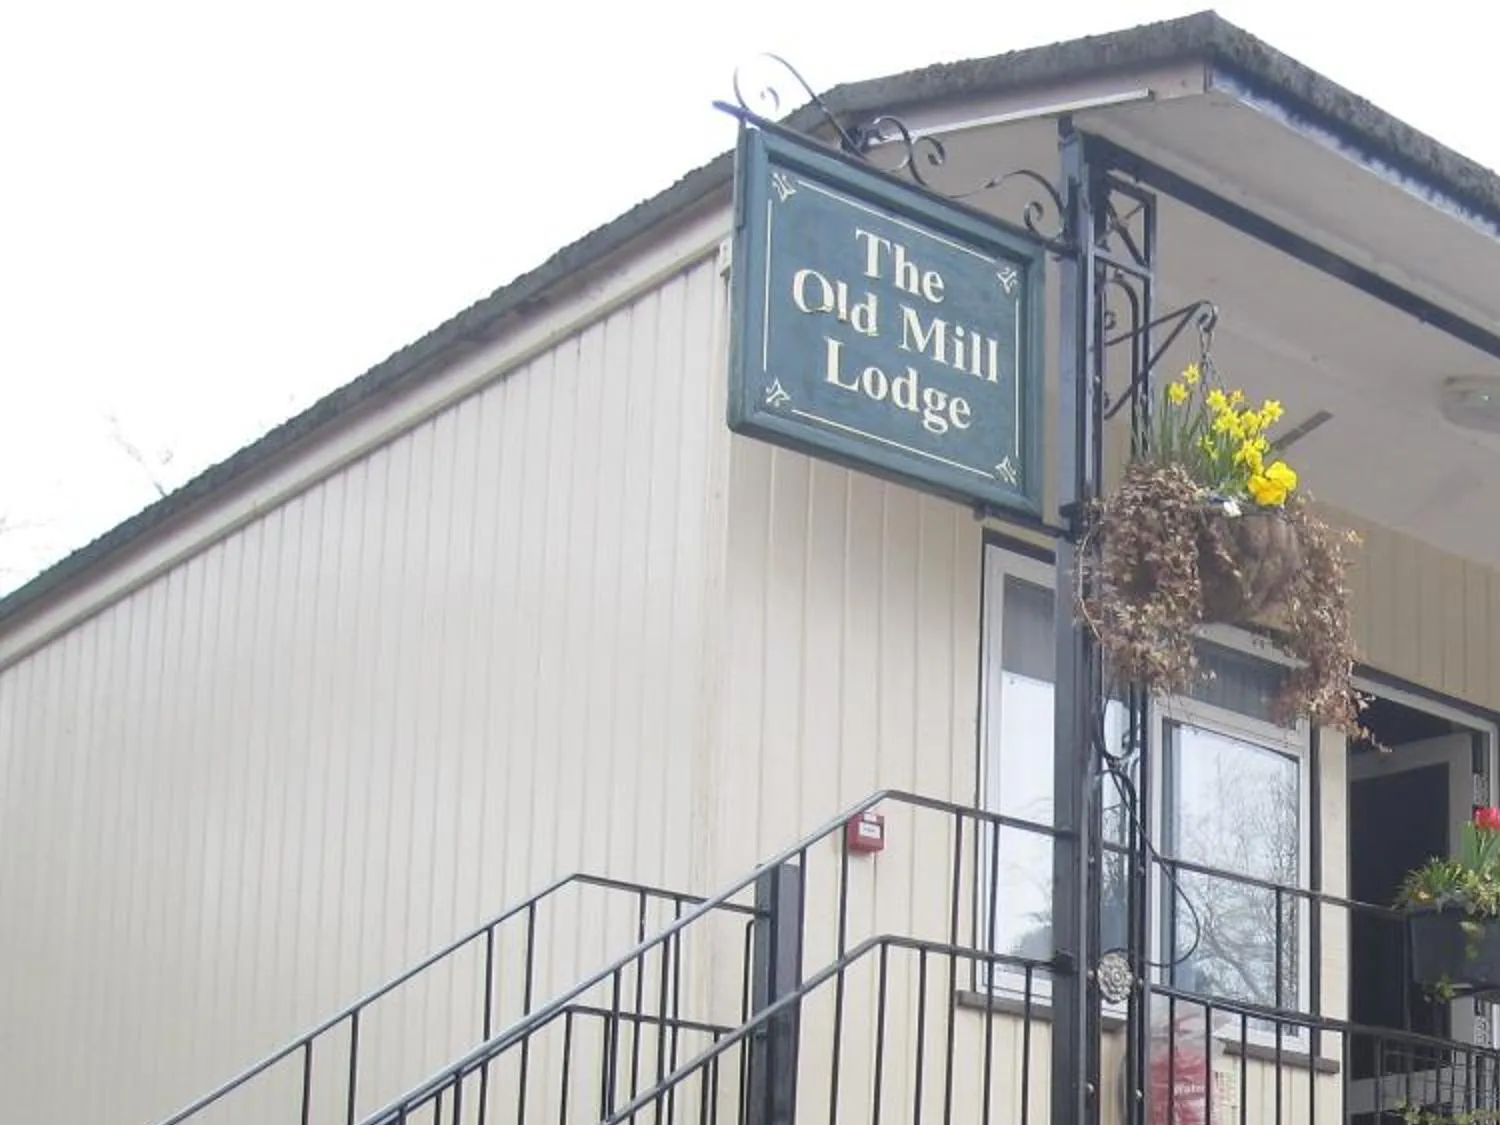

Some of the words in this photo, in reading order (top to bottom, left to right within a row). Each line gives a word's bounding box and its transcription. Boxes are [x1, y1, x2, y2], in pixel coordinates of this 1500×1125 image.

[855, 228, 945, 303] The
[793, 269, 879, 337] Old
[899, 304, 999, 384] Mill
[824, 337, 972, 434] Lodge
